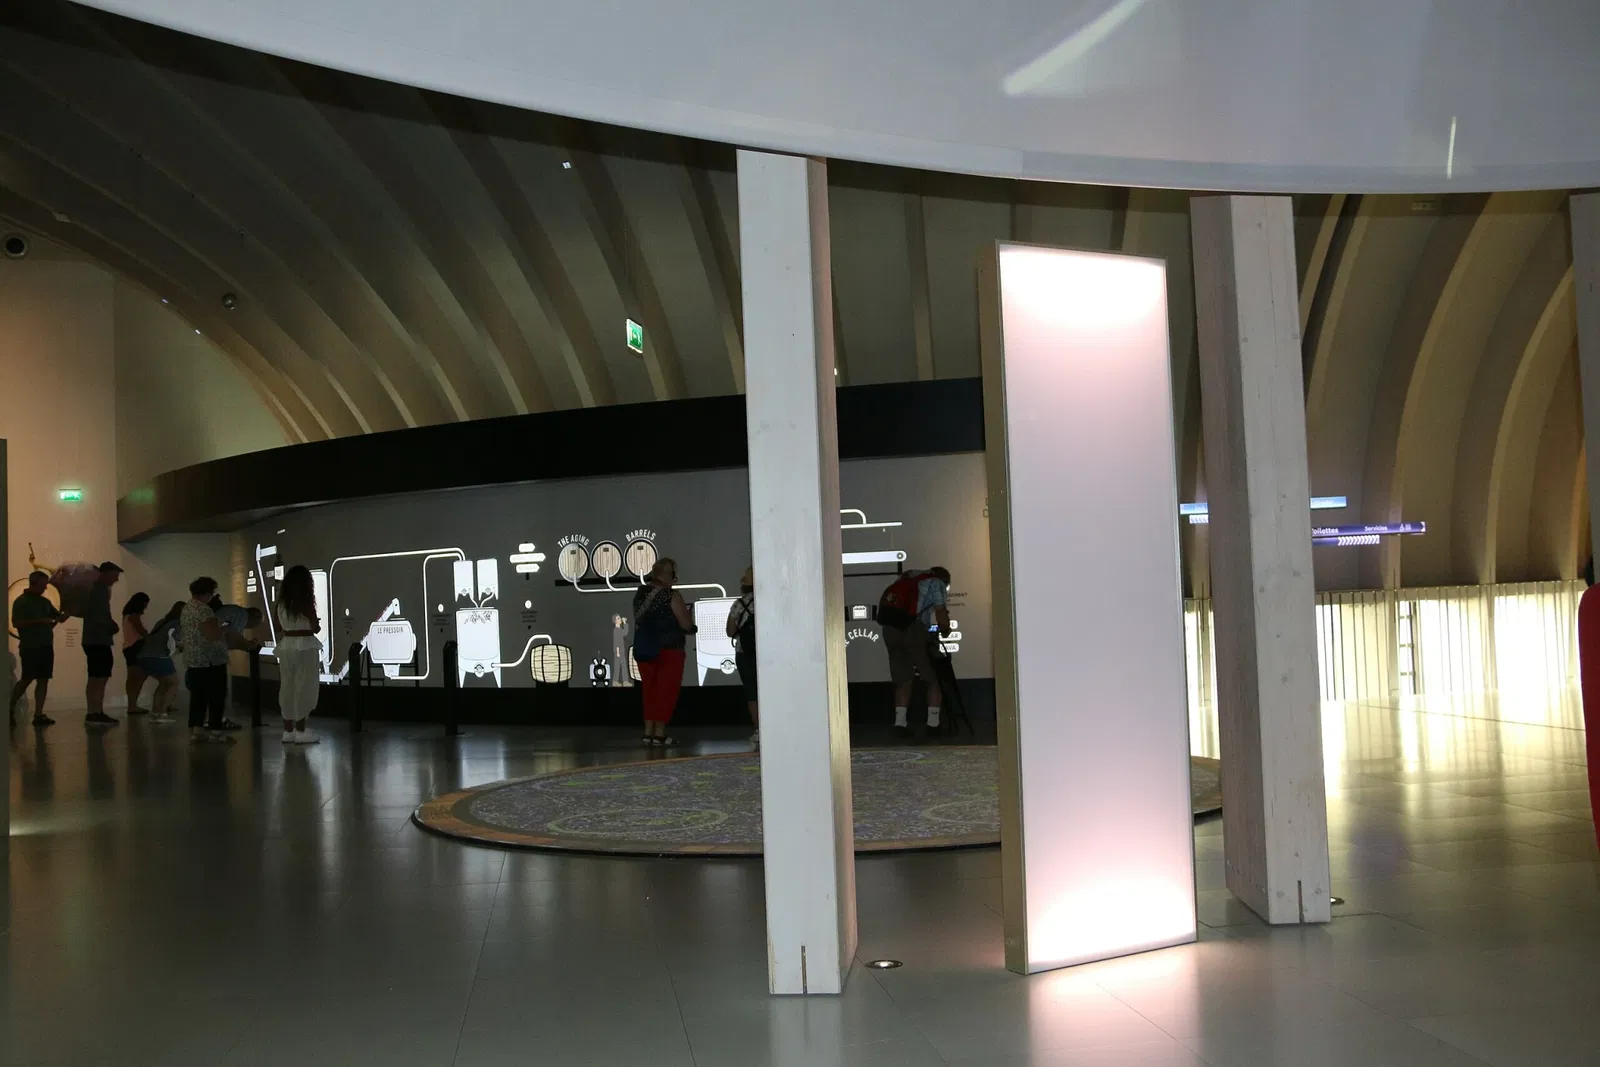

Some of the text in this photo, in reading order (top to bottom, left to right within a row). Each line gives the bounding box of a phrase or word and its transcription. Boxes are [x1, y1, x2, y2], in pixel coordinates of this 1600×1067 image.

[625, 529, 656, 542] BARRELS
[1312, 527, 1339, 535] oilettes
[557, 534, 590, 548] THE AGING
[383, 626, 403, 634] PRESSOIR
[848, 628, 879, 642] CELLAR
